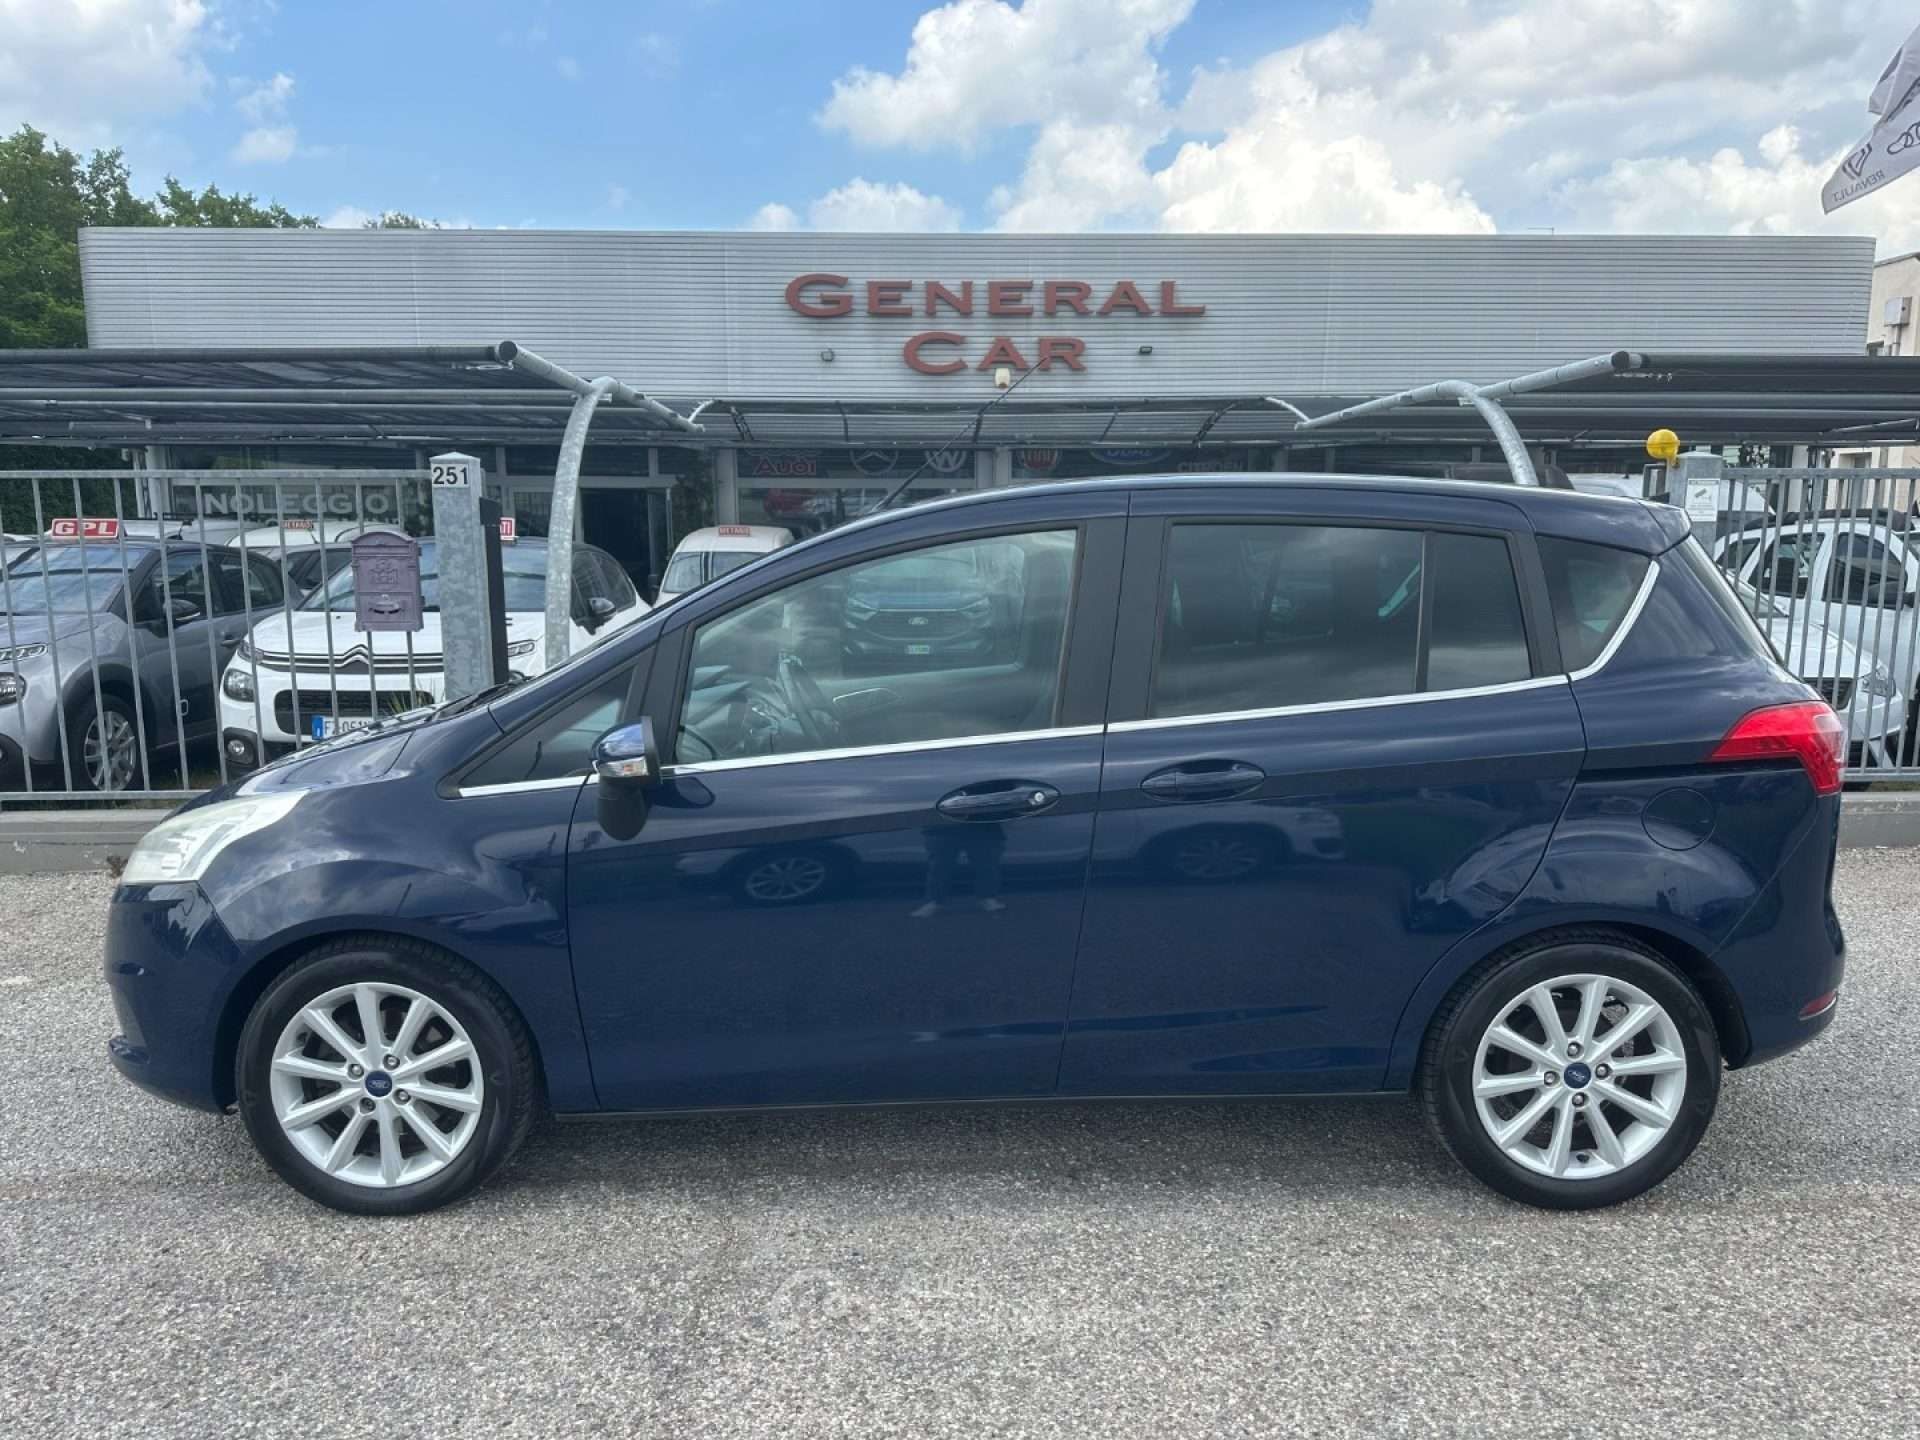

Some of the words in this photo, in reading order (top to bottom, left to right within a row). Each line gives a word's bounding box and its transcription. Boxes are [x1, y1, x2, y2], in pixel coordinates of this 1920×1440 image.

[785, 273, 1206, 318] GENERAL
[903, 331, 1088, 375] CAR
[433, 466, 468, 485] 251
[55, 522, 114, 535] GPL
